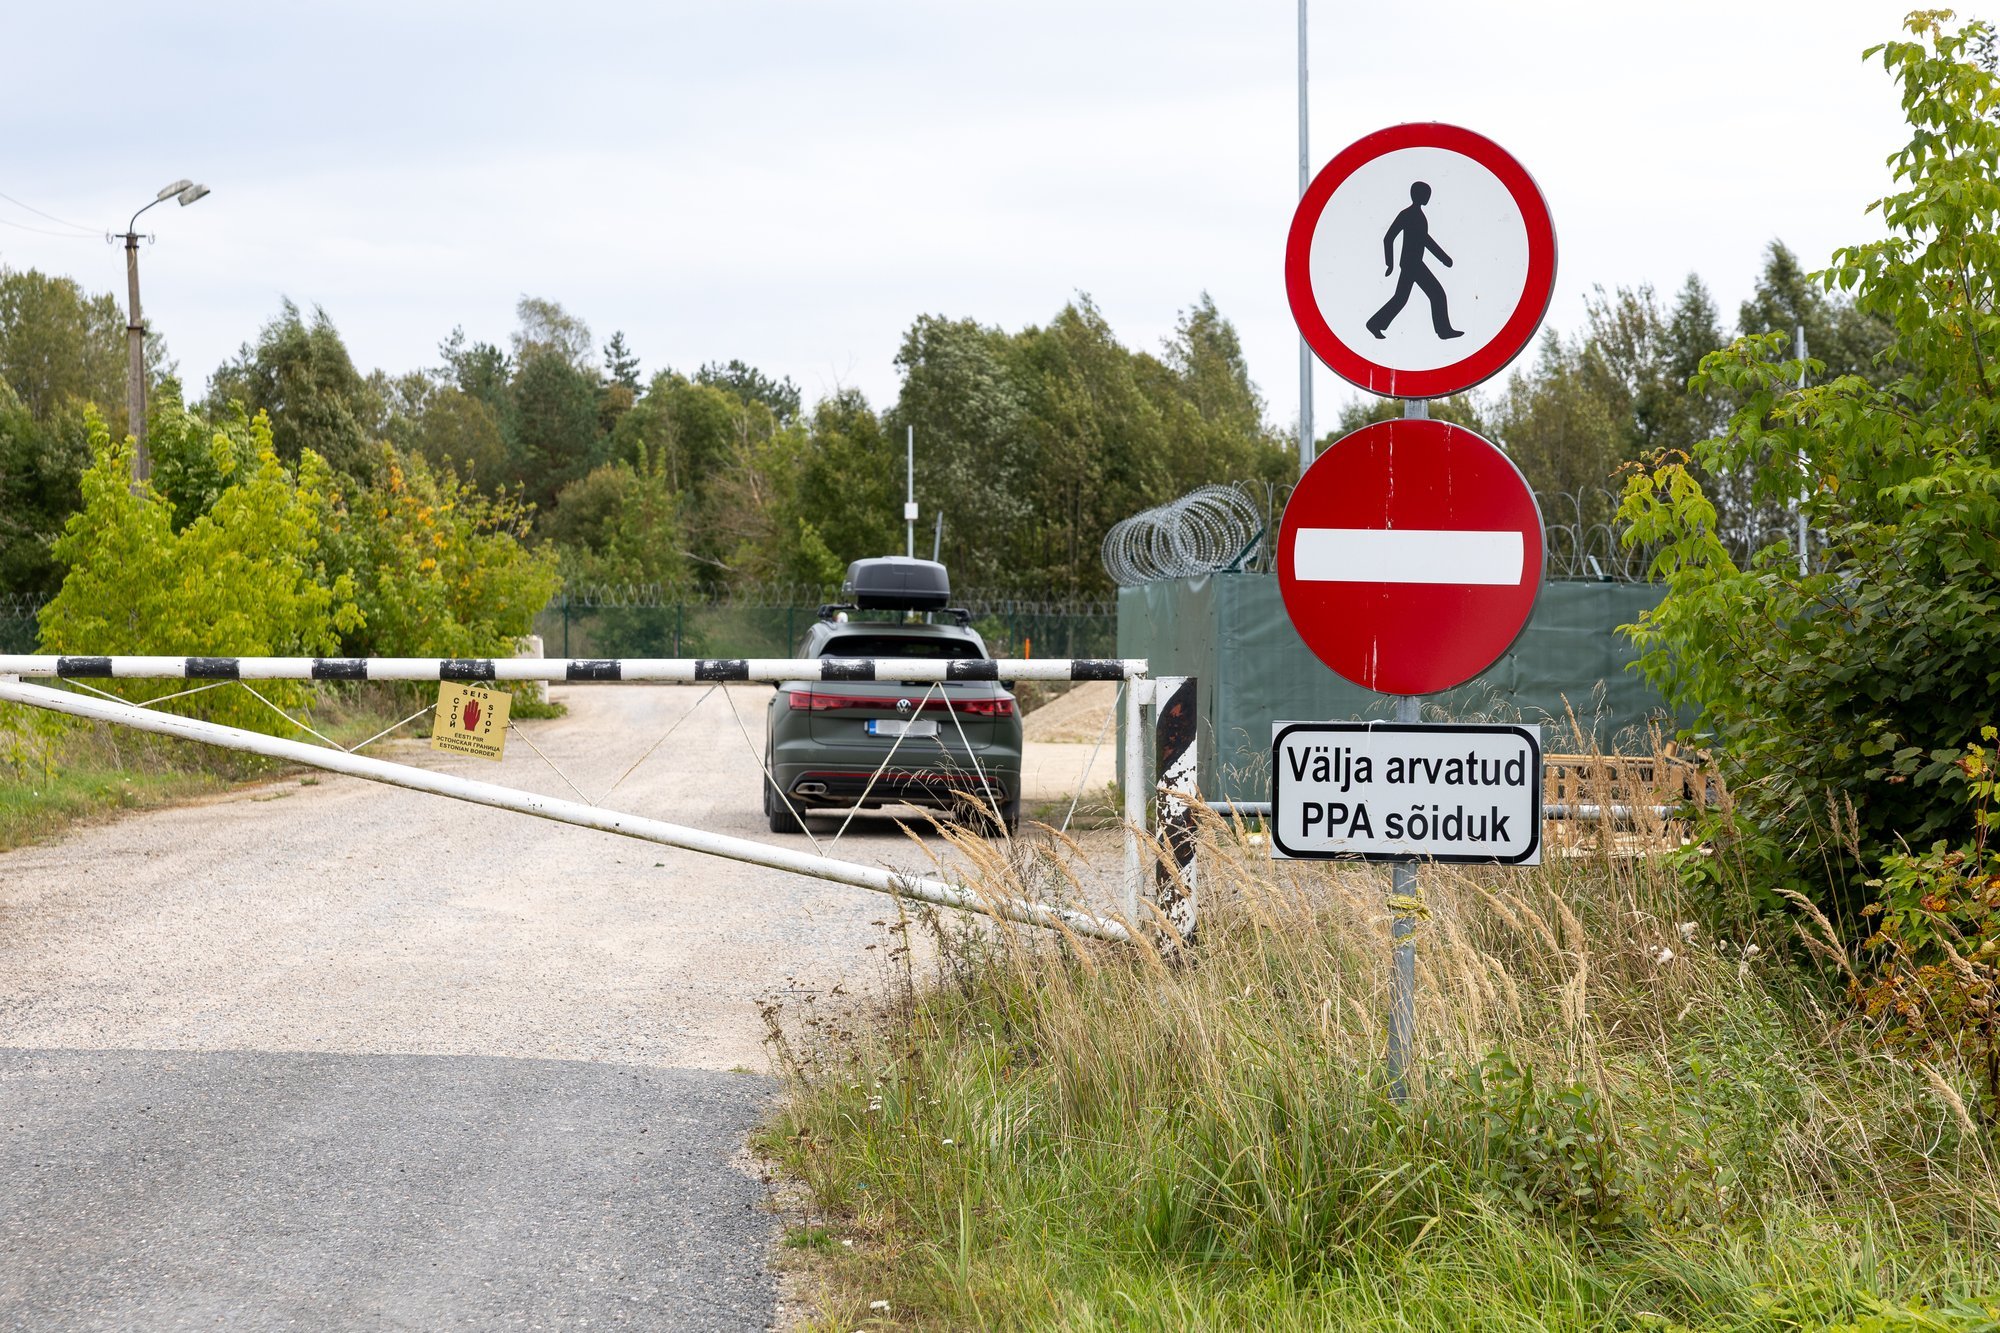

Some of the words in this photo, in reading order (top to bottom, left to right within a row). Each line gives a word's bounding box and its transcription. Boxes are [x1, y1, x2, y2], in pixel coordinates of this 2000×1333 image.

[462, 689, 488, 699] SEIS
[449, 697, 460, 728] СТОЙ
[484, 705, 494, 734] STOP
[436, 735, 472, 747] ЭСТОНСКАЯ
[473, 742, 500, 752] ГРАНИЦА
[454, 732, 472, 740] EESTI
[439, 742, 469, 752] ESTONIAN
[470, 748, 495, 757] BORDER
[1286, 746, 1373, 792] Välja
[1386, 750, 1526, 787] arvatud
[1302, 802, 1374, 839] PPA
[1385, 804, 1511, 842] sõiduk
